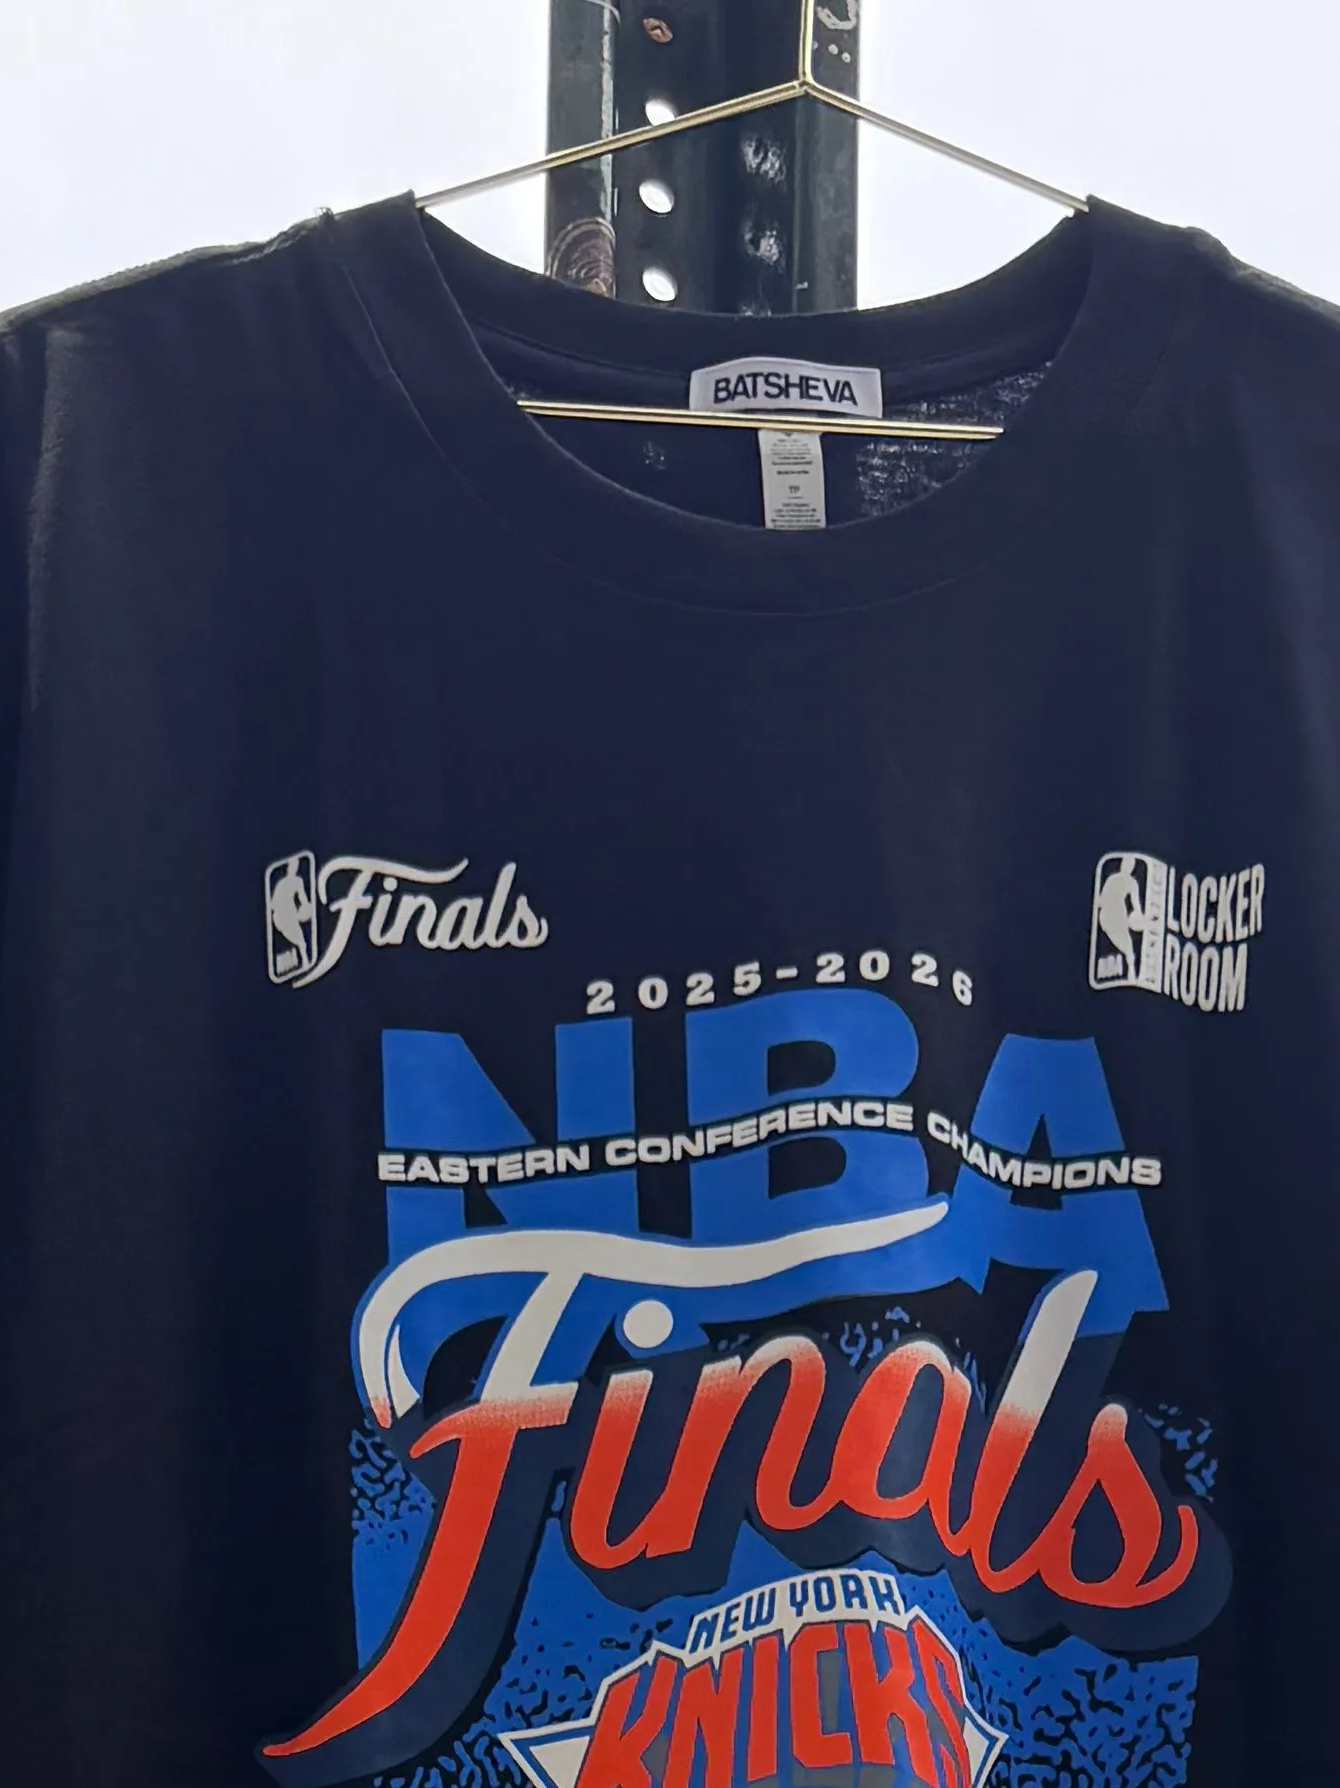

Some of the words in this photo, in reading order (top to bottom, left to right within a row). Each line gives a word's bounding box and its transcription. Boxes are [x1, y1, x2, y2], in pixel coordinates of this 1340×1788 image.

[712, 371, 859, 406] BATSHEVA
[292, 856, 549, 988] Finals
[1167, 863, 1265, 944] LOCKER
[586, 951, 974, 1015] 2025-2026
[1163, 932, 1248, 1013] ROOM
[377, 1142, 590, 1184] EASTERN
[604, 1099, 914, 1168] CONFERENCE
[925, 1109, 1164, 1190] CHAMPIONS
[380, 988, 1170, 1312] NBA
[262, 1202, 1200, 1758] Finals
[689, 1586, 777, 1654] NEW
[789, 1573, 902, 1618] YORK
